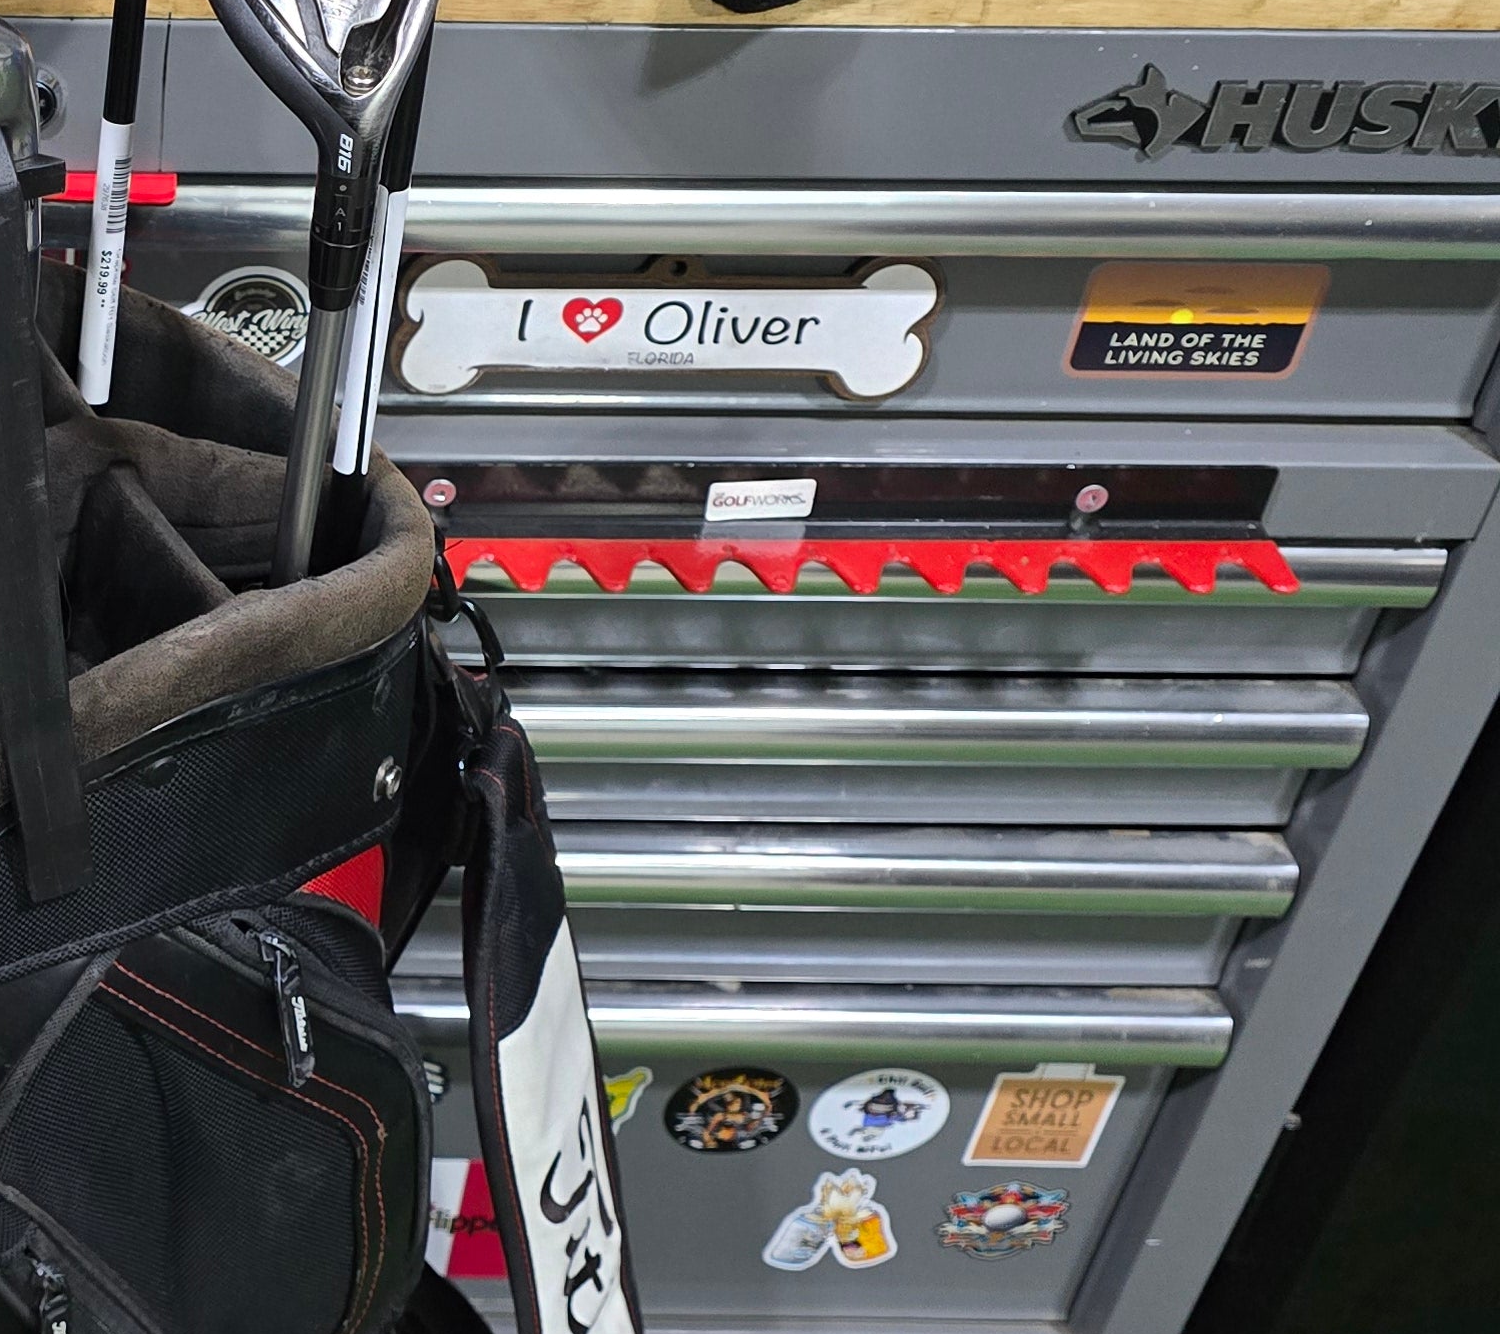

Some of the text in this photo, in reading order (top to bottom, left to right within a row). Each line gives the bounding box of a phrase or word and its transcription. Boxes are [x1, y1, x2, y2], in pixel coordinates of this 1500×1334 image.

[1200, 79, 1500, 155] HUSK
[338, 133, 354, 174] 816
[334, 207, 346, 217] A
[96, 249, 111, 296] $219.99
[253, 307, 310, 340] Wing
[517, 299, 820, 346] I Oliver
[1109, 332, 1267, 349] LAND OF THE
[627, 351, 695, 367] FLORIDA
[1104, 350, 1260, 367] LIVING SKIES
[1008, 1087, 1095, 1111] SHOP
[1002, 1108, 1081, 1130] SMALL
[990, 1136, 1072, 1155] LOCAL
